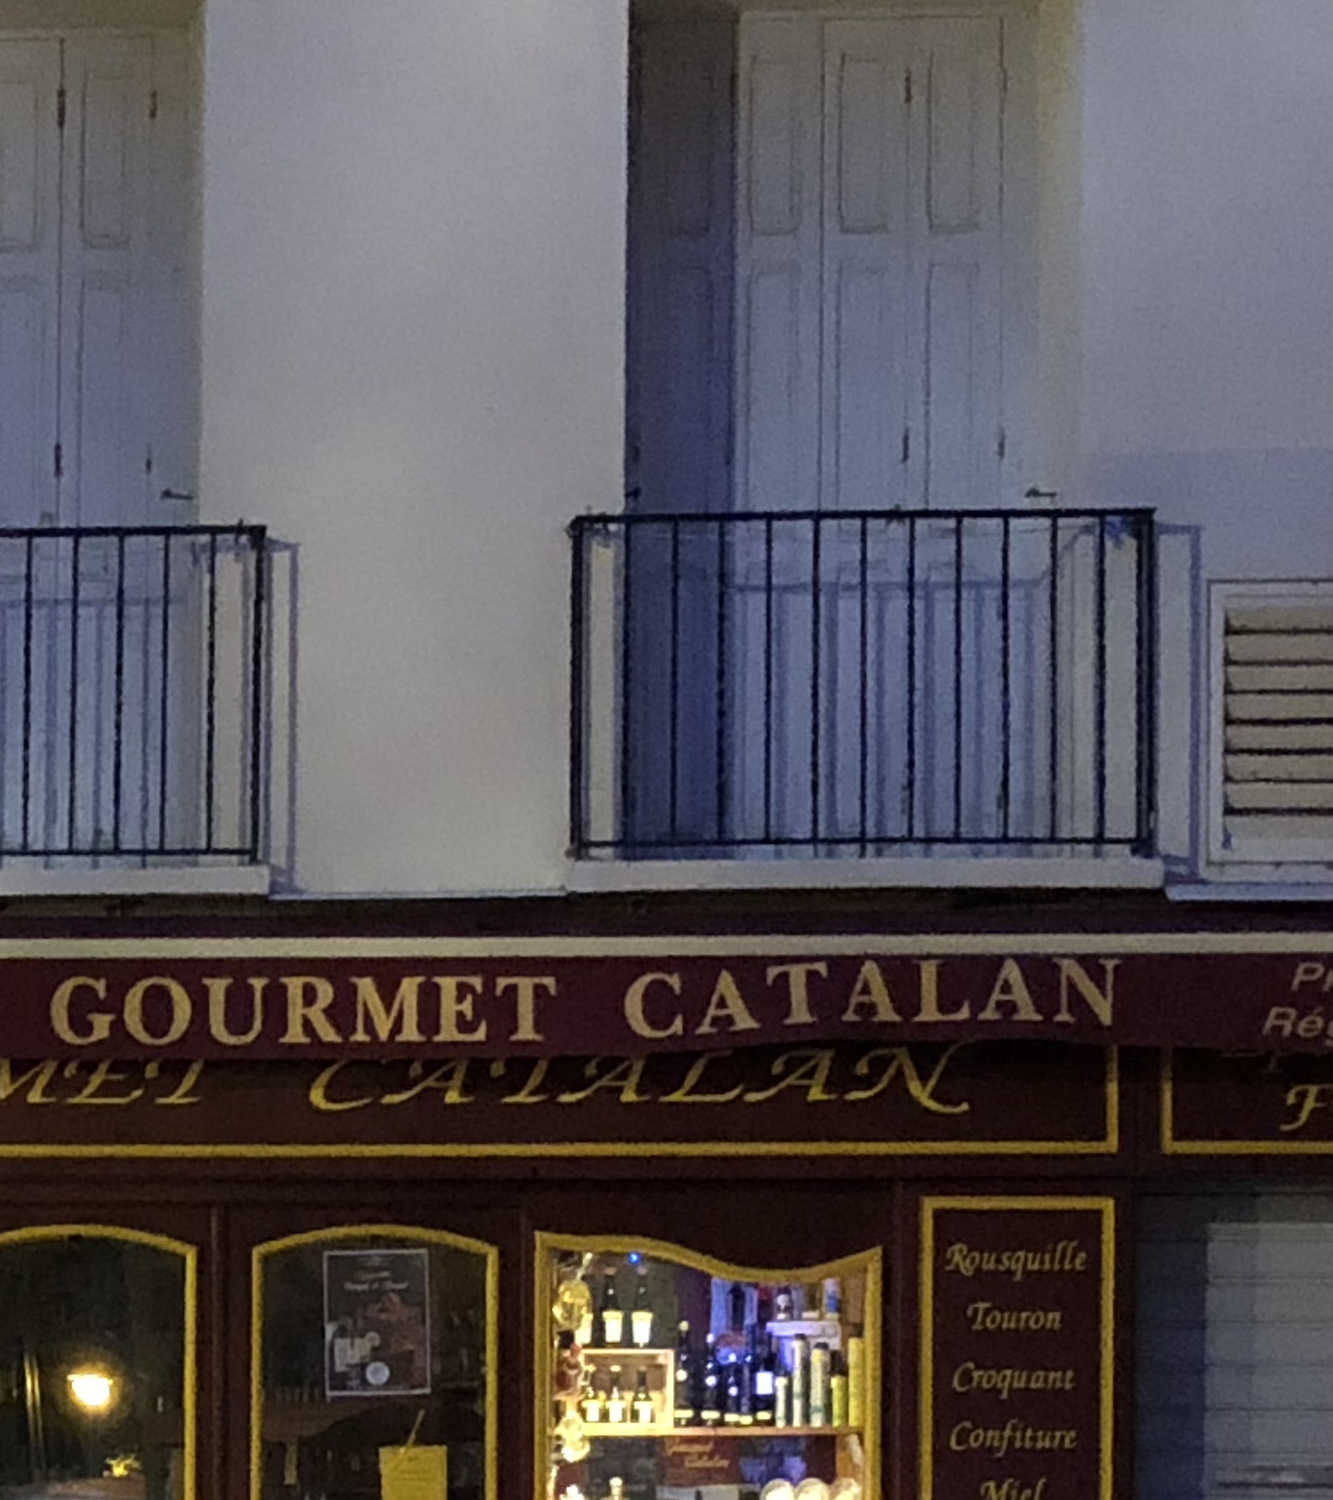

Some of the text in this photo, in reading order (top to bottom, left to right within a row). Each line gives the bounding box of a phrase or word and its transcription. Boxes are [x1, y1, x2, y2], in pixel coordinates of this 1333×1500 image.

[50, 956, 1120, 1047] GOURMET CATALAN
[945, 1241, 1087, 1281] Rousquille
[967, 1301, 1061, 1331] Touron
[953, 1361, 1075, 1399] Croquant
[950, 1420, 1078, 1458] Confiture
